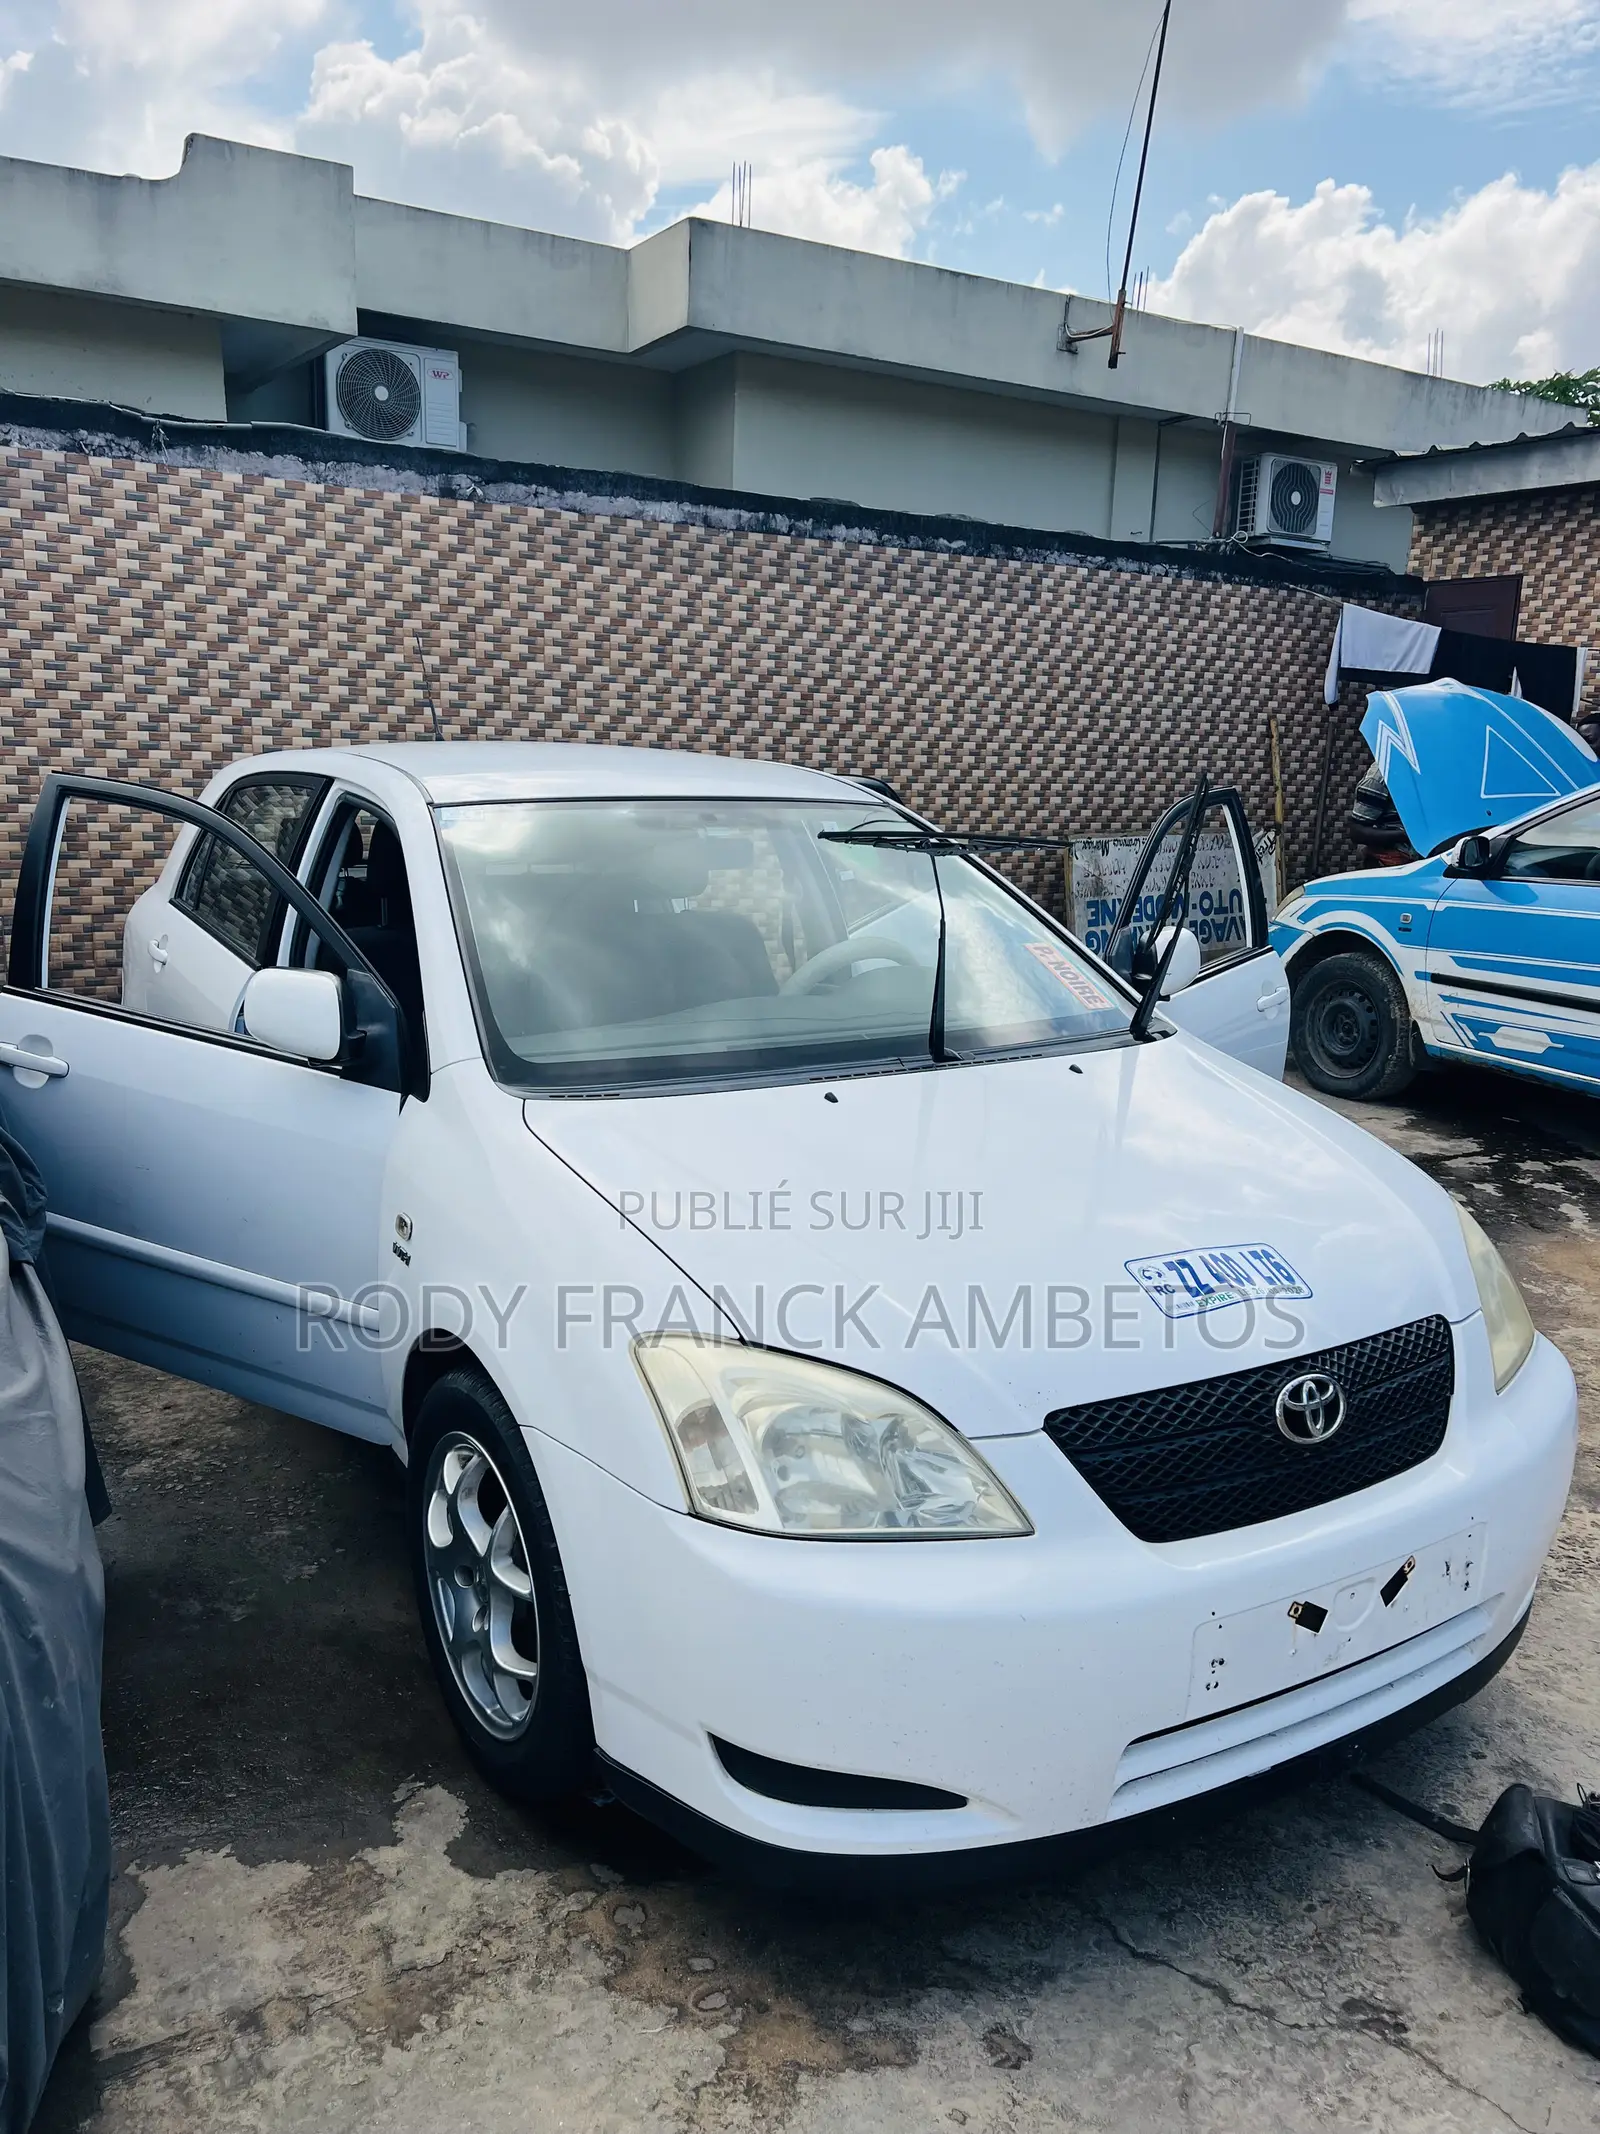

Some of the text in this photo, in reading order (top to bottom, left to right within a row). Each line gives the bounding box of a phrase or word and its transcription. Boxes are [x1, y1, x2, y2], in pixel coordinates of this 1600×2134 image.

[1163, 1249, 1297, 1298] ZZ 400 LT6
[1153, 1283, 1177, 1296] RC
[1196, 1292, 1234, 1308] EXPIRE
